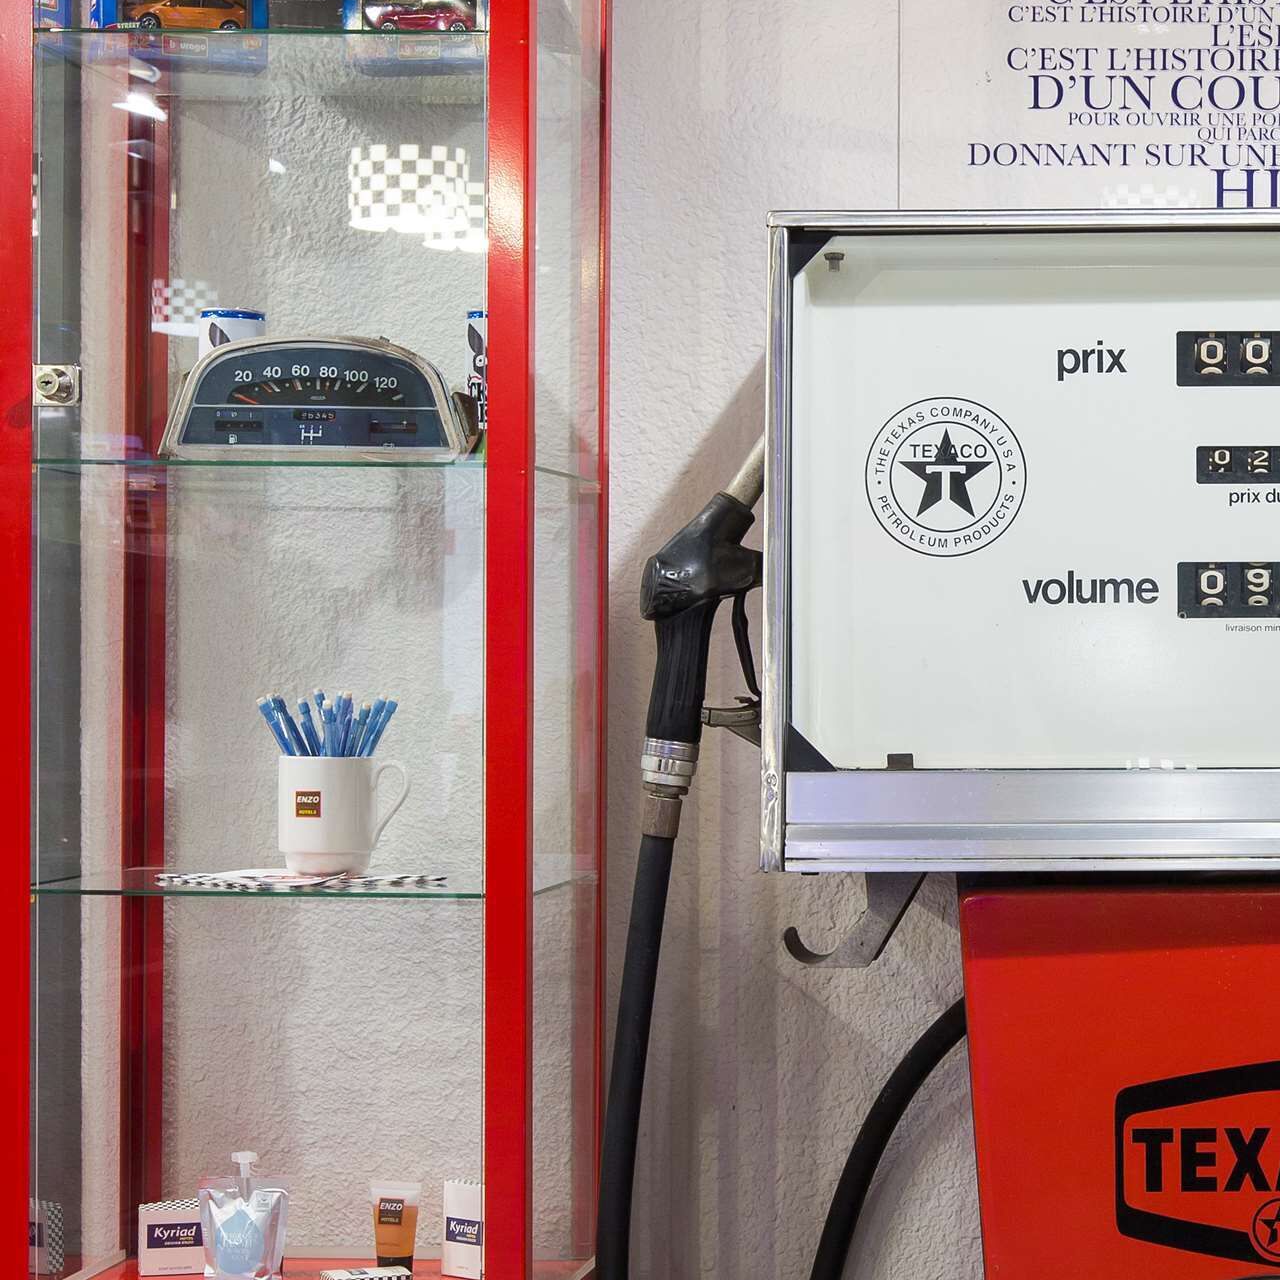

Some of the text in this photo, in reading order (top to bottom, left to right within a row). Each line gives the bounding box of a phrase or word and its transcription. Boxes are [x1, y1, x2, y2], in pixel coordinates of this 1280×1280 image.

[1007, 7, 1073, 24] C'EST
[1081, 7, 1210, 24] L'HISTOIRE
[1218, 7, 1277, 24] D'UN
[1007, 47, 1098, 72] C'EST
[1028, 75, 1153, 110] D'UN
[1068, 112, 1120, 126] POUR
[1126, 112, 1201, 126] OUVRIR
[1208, 113, 1247, 126] UNE
[1197, 127, 1232, 144] QUI
[968, 143, 1136, 166] DONNANT
[1145, 144, 1210, 166] SUR
[1056, 340, 1128, 381] prix
[234, 365, 397, 389] 20 40 60 80 100 120
[875, 448, 890, 475] THE
[885, 411, 925, 446] TEXAS
[930, 406, 999, 435] COMPANY
[909, 443, 988, 459] TEXACO
[1229, 488, 1260, 507] prix
[878, 493, 1015, 549] PETROLEUM PRODUCTS
[1022, 570, 1160, 605] volume
[1225, 623, 1262, 632] livraison
[296, 795, 320, 803] ENZO
[379, 1202, 403, 1211] ENZO
[154, 1225, 197, 1240] Kyriad
[449, 1221, 479, 1235] Kyriad
